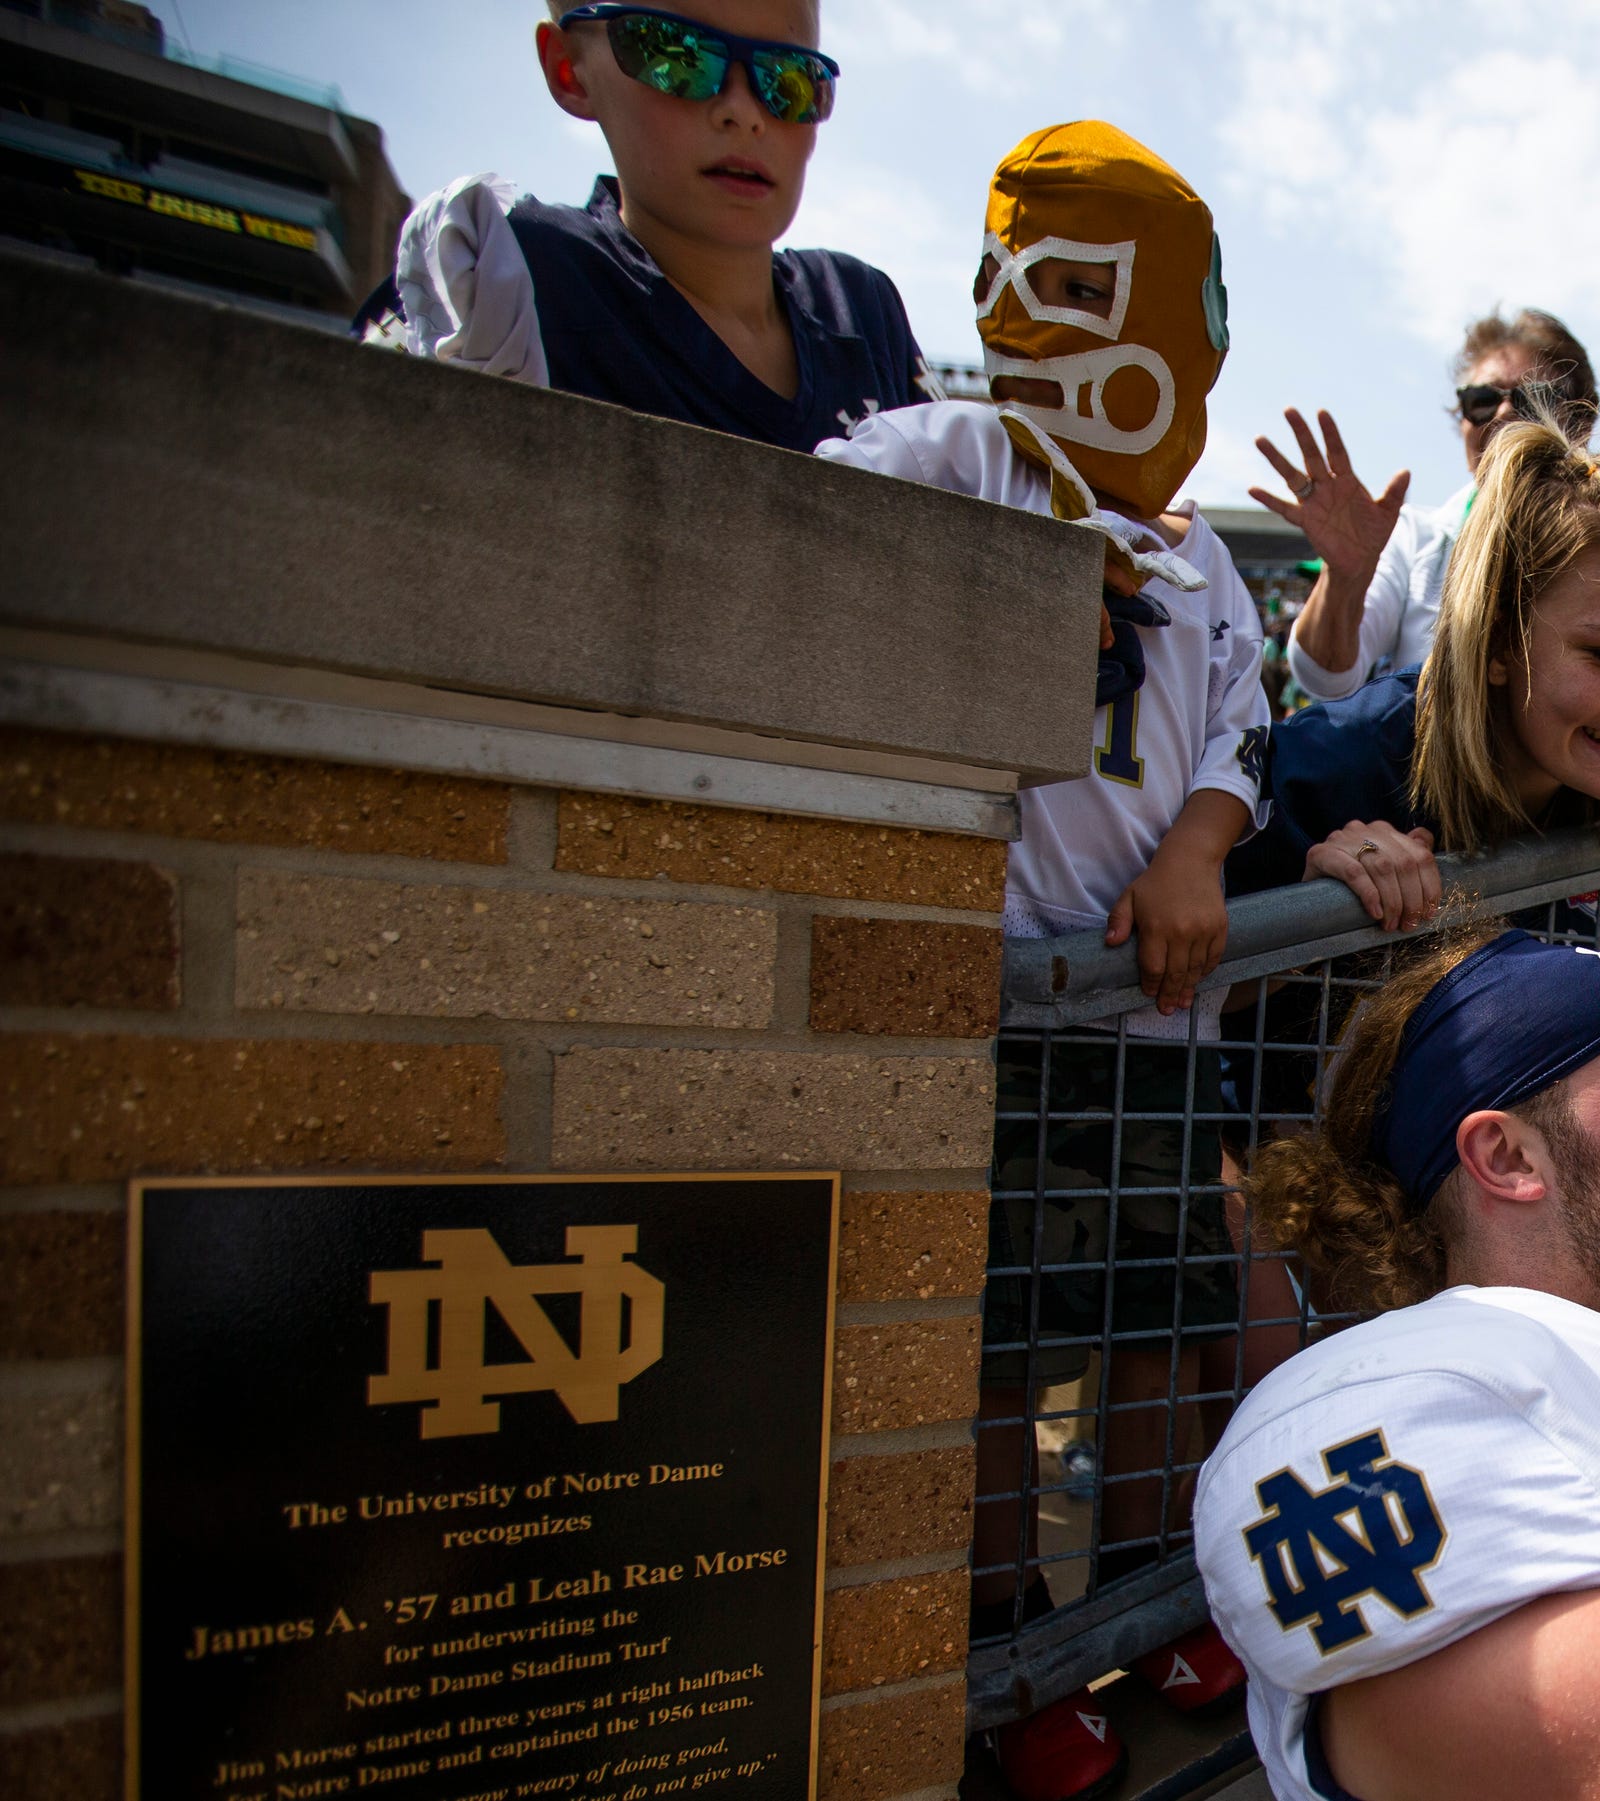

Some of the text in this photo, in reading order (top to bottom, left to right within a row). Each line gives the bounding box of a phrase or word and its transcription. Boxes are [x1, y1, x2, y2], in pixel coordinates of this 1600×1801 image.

[147, 191, 242, 234] IRISH
[283, 1463, 724, 1528] The University of Notre Dame
[442, 1514, 592, 1549] recognizes
[186, 1619, 315, 1659] James
[325, 1607, 368, 1635] A.
[449, 1583, 515, 1616] and
[528, 1569, 611, 1604] Leah
[624, 1564, 684, 1589] Rae
[694, 1549, 787, 1578] Morse
[384, 1609, 639, 1665] for underwriting the
[345, 1636, 672, 1711] Notre Dame Stadium Turf
[214, 1663, 764, 1785] Jim Morse started three years at right halfback
[276, 1776, 350, 1800] Notre
[358, 1760, 431, 1787] Dame
[437, 1745, 482, 1771] and
[489, 1720, 598, 1760] captained
[606, 1717, 639, 1735] the
[648, 1704, 694, 1727] 1956
[700, 1696, 754, 1716] team.
[516, 1773, 580, 1797] weary
[585, 1761, 612, 1784] of
[613, 1753, 671, 1777] doing
[676, 1737, 729, 1766] good,
[622, 1784, 648, 1801] do
[654, 1775, 687, 1795] not
[691, 1767, 731, 1790] give
